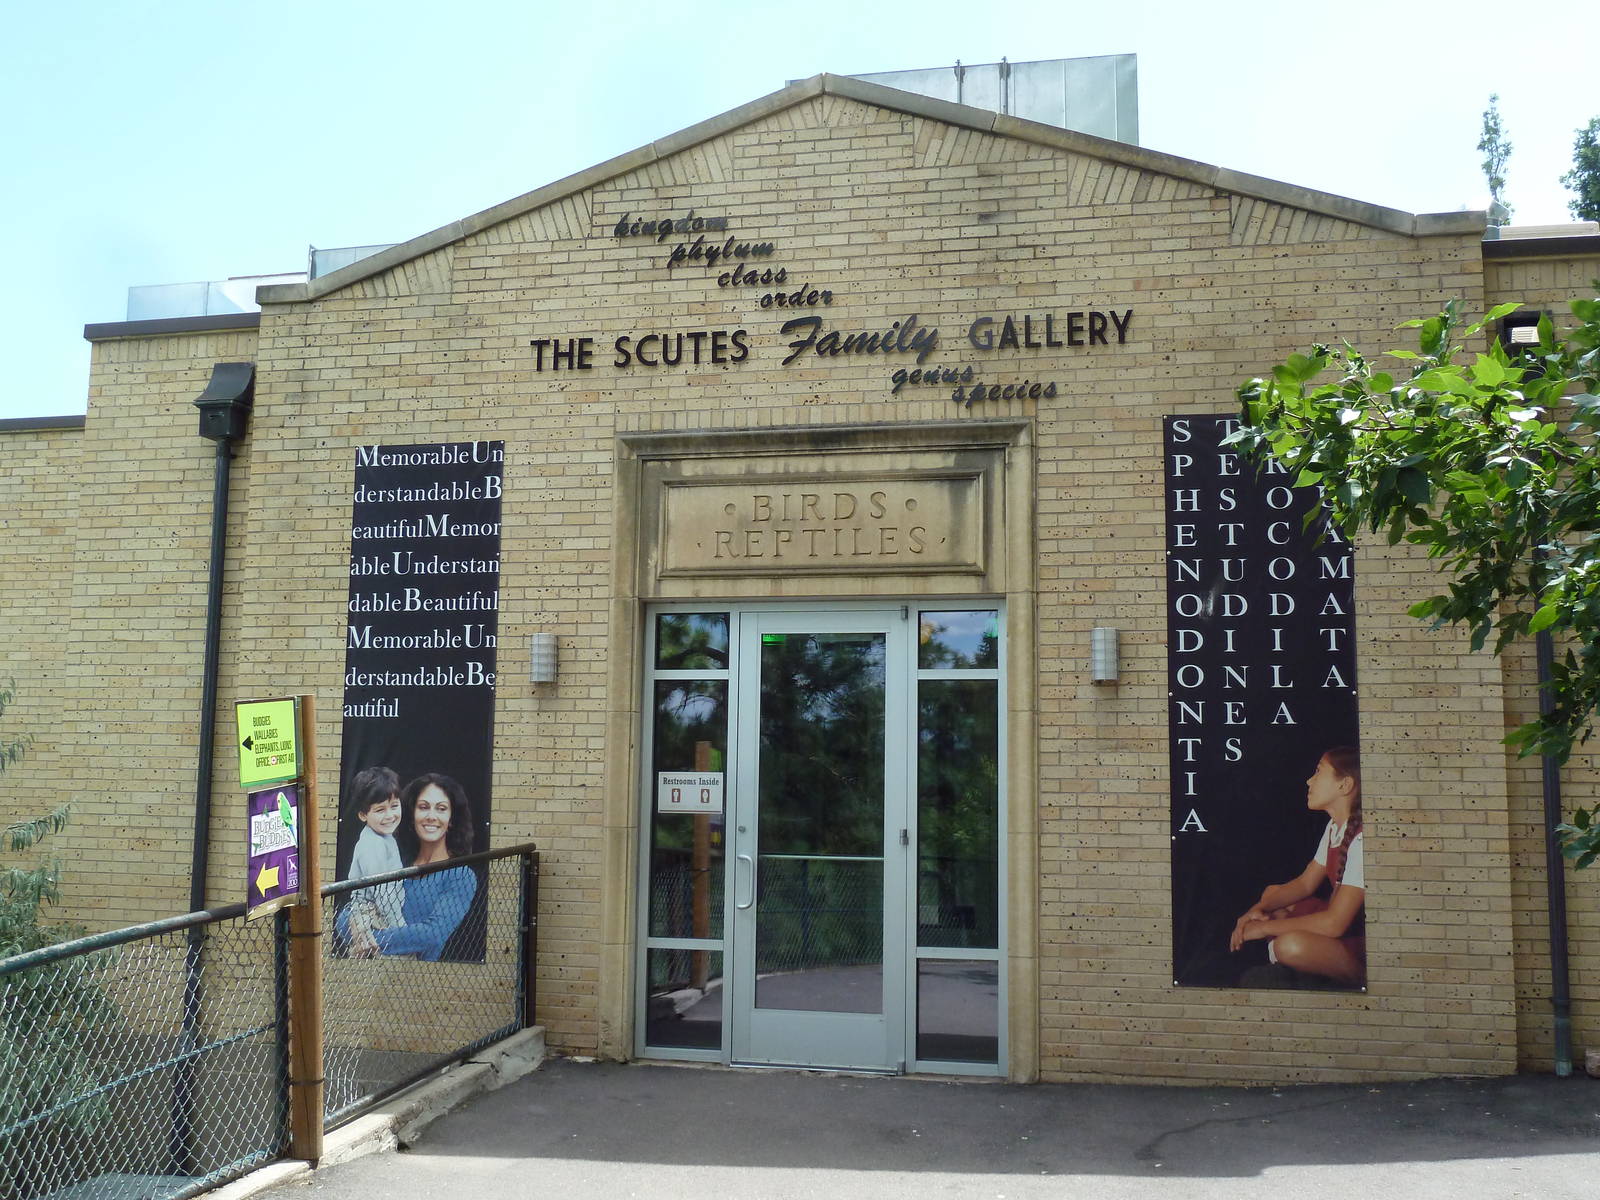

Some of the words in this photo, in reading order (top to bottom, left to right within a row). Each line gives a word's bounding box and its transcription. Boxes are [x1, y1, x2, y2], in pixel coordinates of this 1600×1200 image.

[614, 209, 729, 242] kingdom
[667, 235, 774, 268] phylum
[717, 263, 788, 288] class
[760, 283, 833, 308] order
[530, 336, 594, 373] THE
[614, 329, 750, 368] SCUTES
[780, 314, 939, 366] Family
[968, 309, 1134, 351] GALLERY
[891, 365, 974, 395] genus
[952, 381, 1058, 408] species
[752, 491, 888, 522] BIRDS
[713, 526, 928, 559] REPTILES
[1215, 419, 1249, 763] TESTUDINES
[1264, 452, 1298, 726] ROCODILA
[1171, 419, 1208, 833] SPHENODONTIA
[253, 716, 271, 727] BUDGIES
[343, 698, 400, 718] autiful
[254, 729, 278, 740] WALLABIES
[663, 777, 697, 785] Restrooms
[698, 778, 719, 786] Inside
